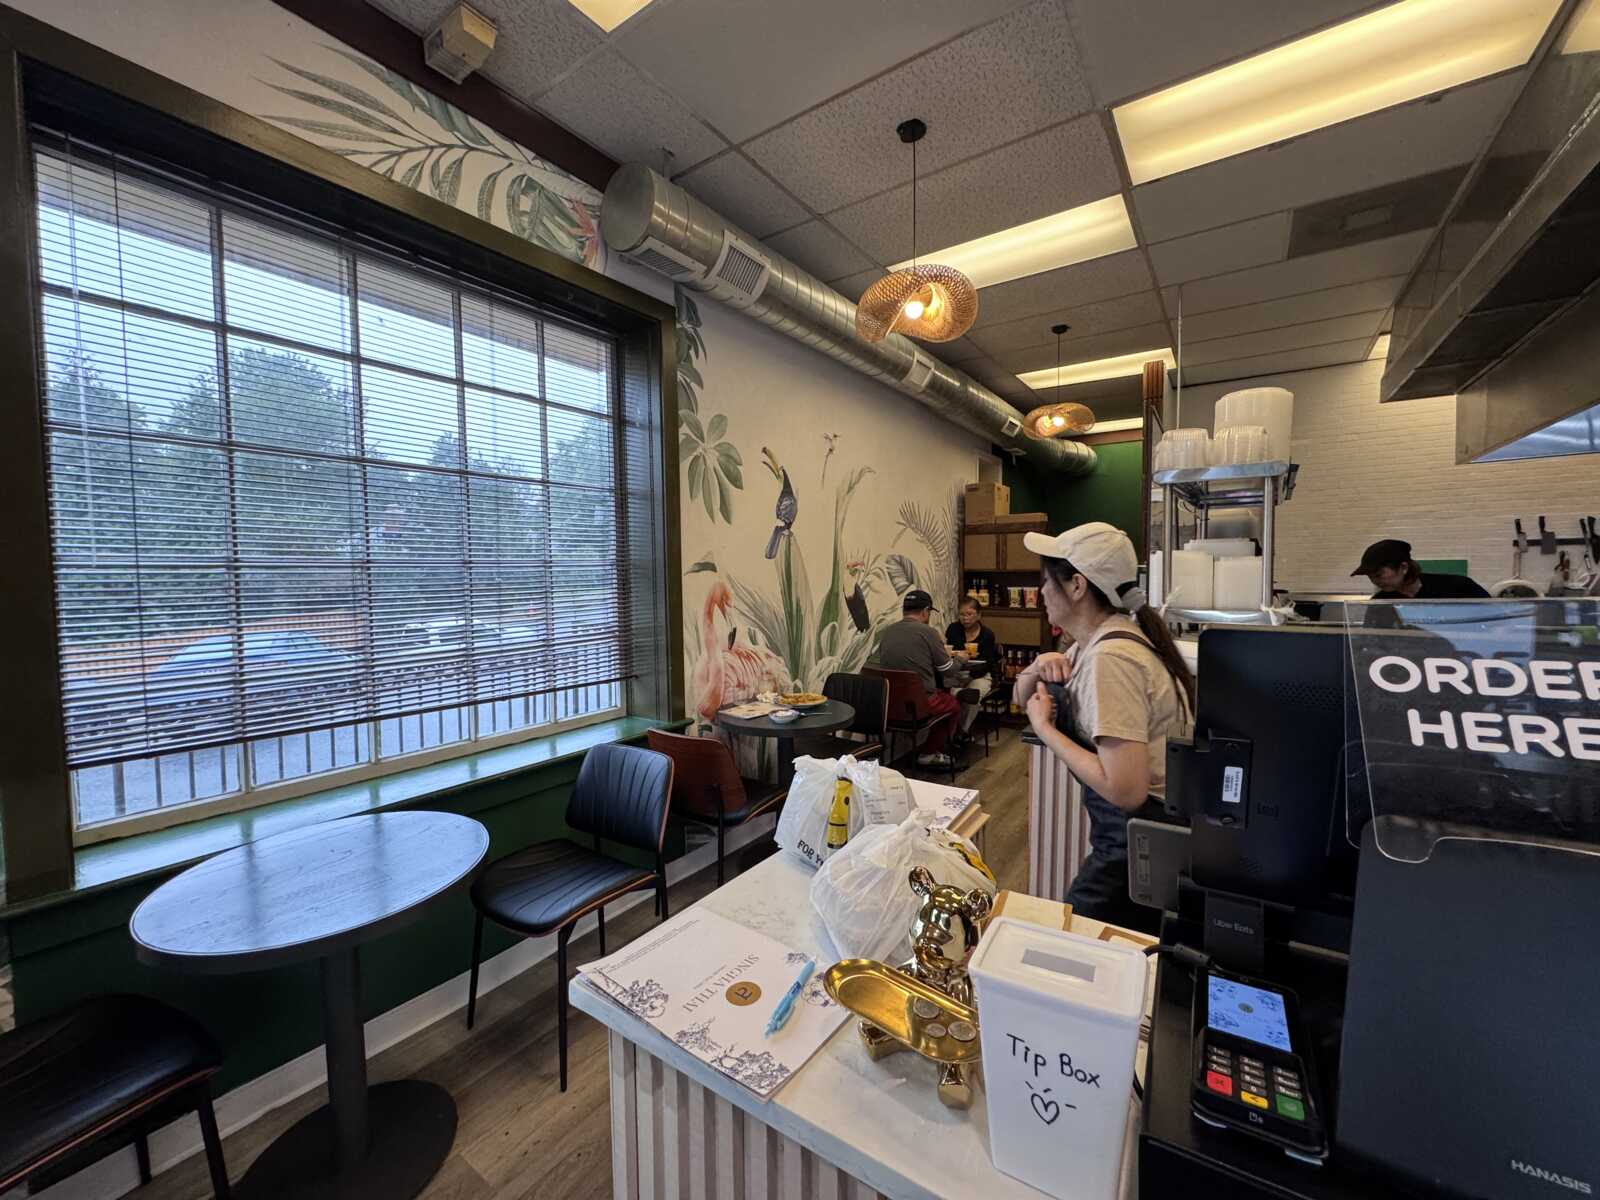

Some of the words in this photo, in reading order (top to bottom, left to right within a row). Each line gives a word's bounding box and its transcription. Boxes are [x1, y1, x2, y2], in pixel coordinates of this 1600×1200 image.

[1407, 708, 1600, 761] HERE
[797, 840, 815, 860] FOR
[1212, 917, 1233, 929] Uber
[1234, 921, 1255, 935] Eats
[712, 952, 760, 989] SINGHA
[682, 984, 718, 1014] THAI
[1006, 1032, 1047, 1077] Tip
[1059, 1052, 1101, 1089] Box
[1511, 1159, 1592, 1194] HANASIS
